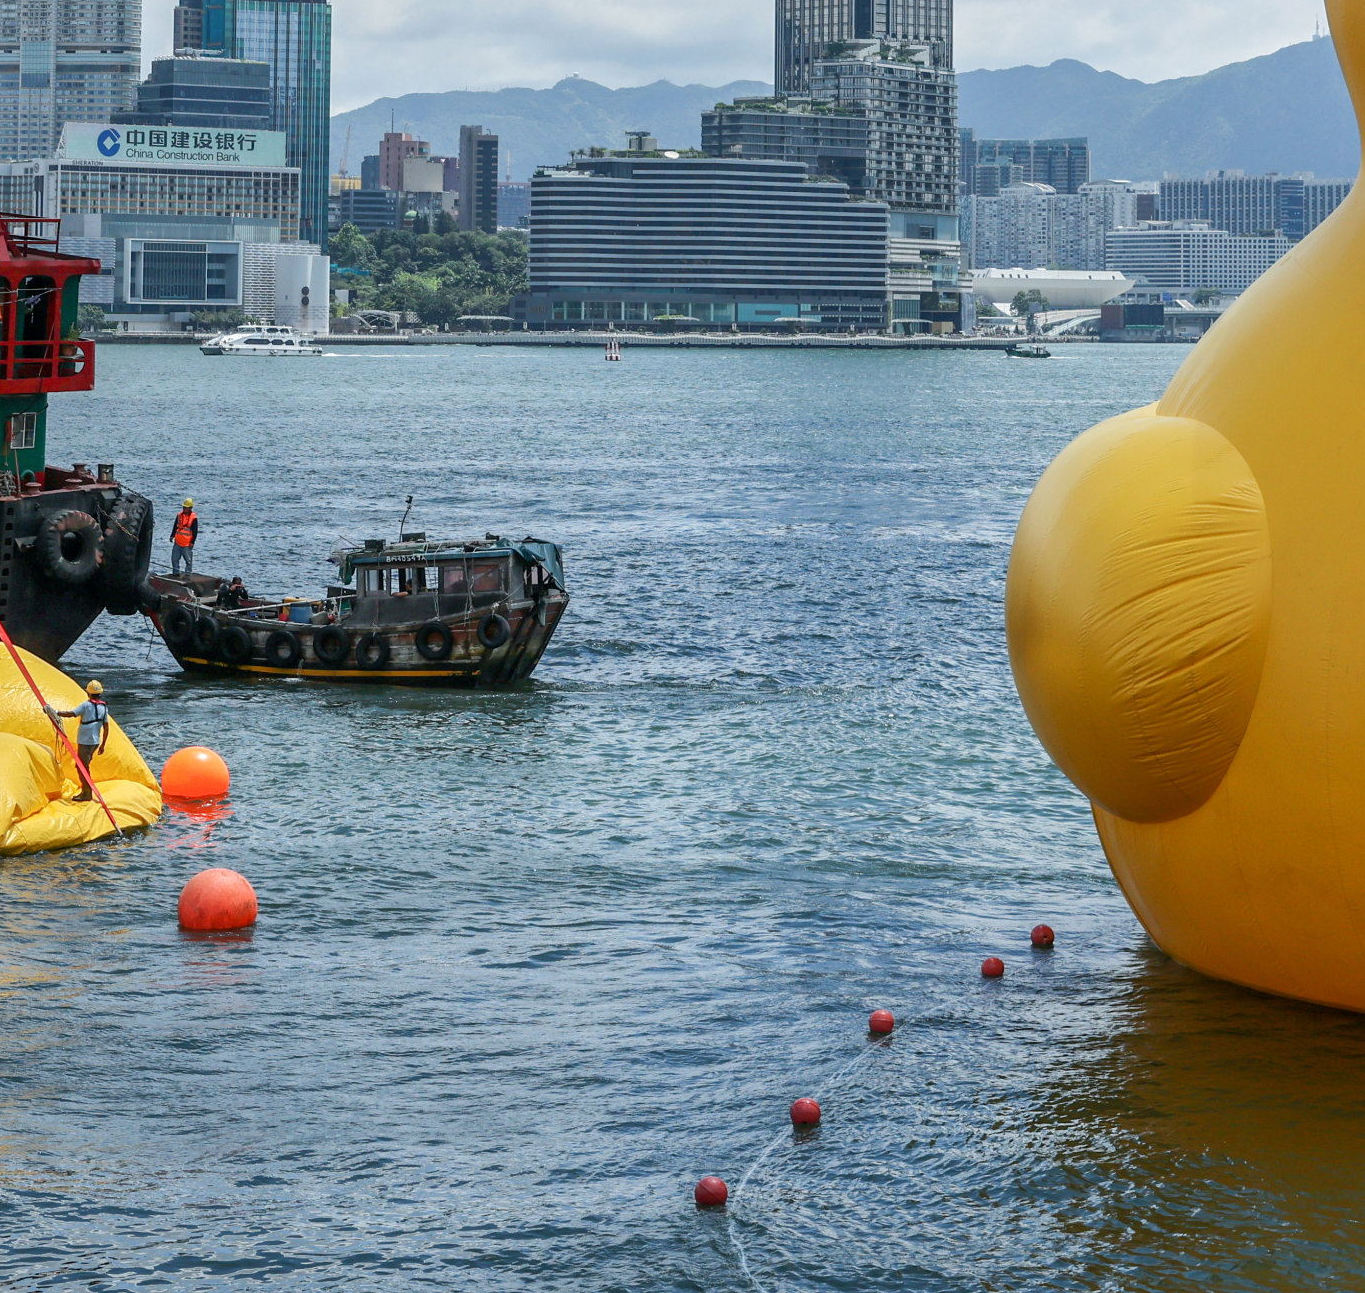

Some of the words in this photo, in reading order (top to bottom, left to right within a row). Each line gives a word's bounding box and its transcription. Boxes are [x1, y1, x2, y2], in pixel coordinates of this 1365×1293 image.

[126, 129, 257, 151] 中国建设银行
[126, 148, 153, 159] China
[156, 149, 214, 161] Construction
[216, 151, 240, 162] Bank
